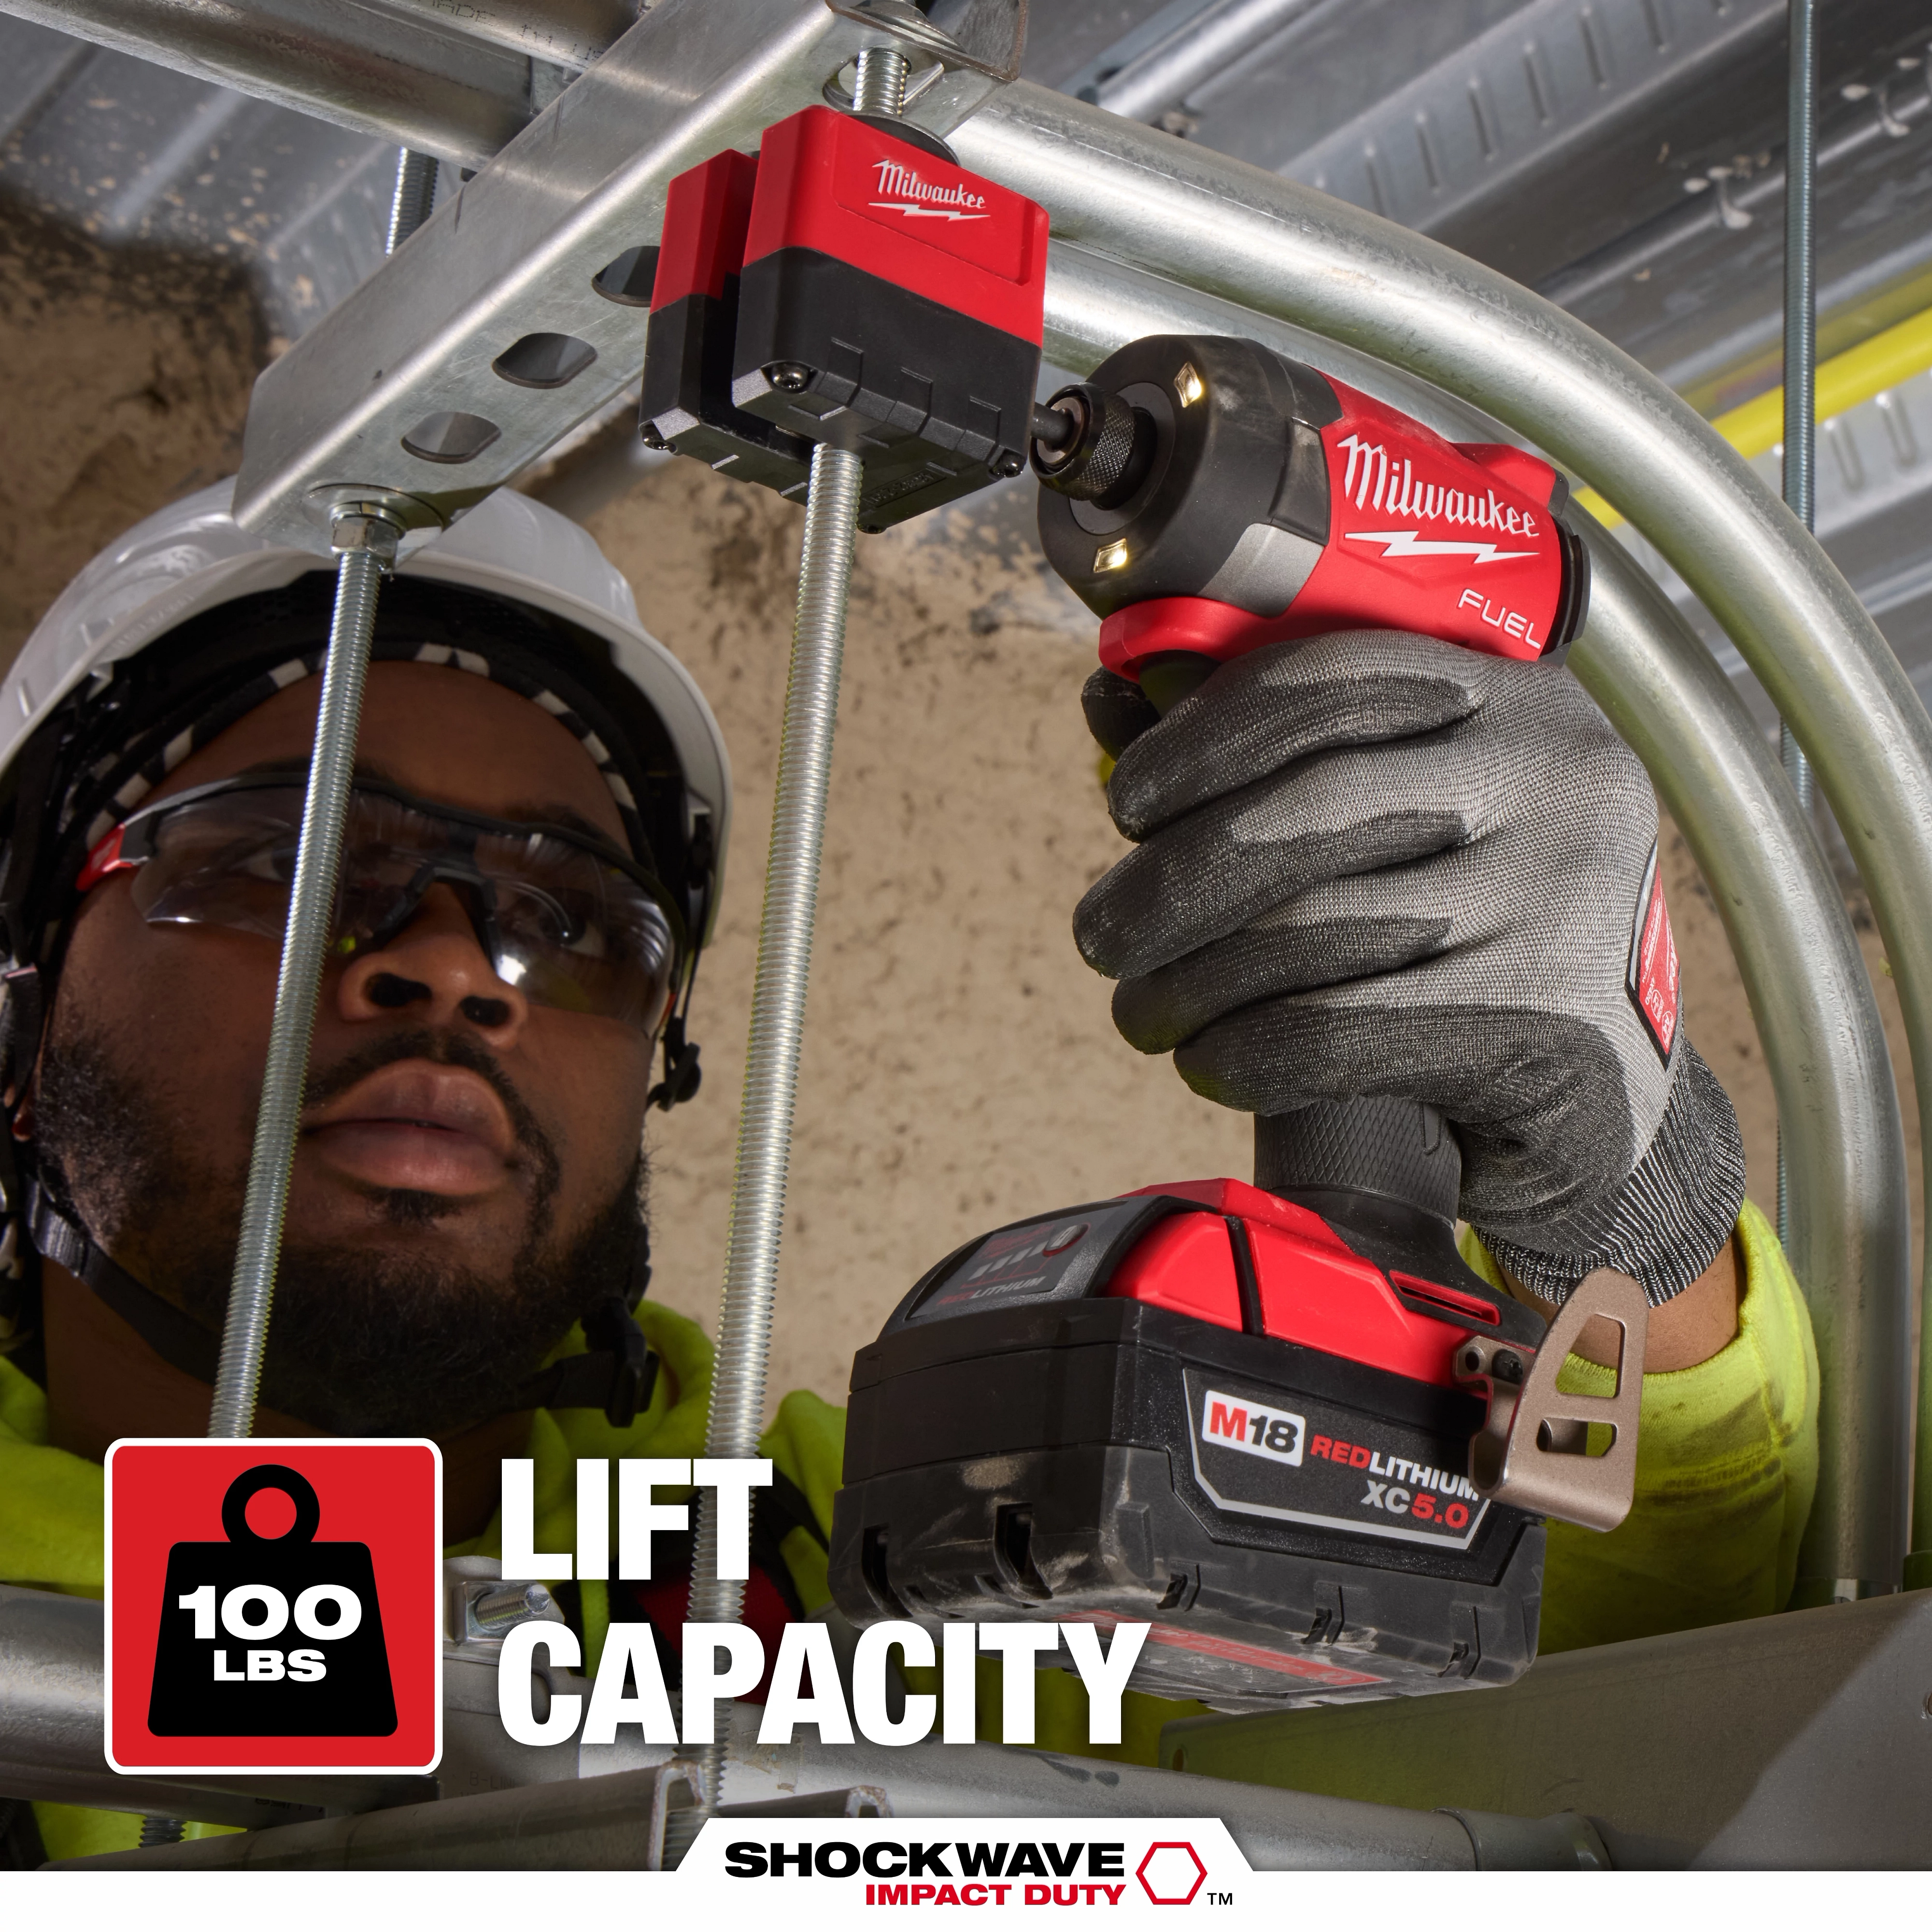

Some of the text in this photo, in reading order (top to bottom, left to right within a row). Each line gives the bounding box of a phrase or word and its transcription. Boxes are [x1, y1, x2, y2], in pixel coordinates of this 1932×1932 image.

[872, 159, 986, 209] Milwaukee
[1337, 434, 1539, 538] Milwaukee
[1457, 588, 1541, 650] FUEL
[1209, 1402, 1479, 1501] M18 REDLITHIUM
